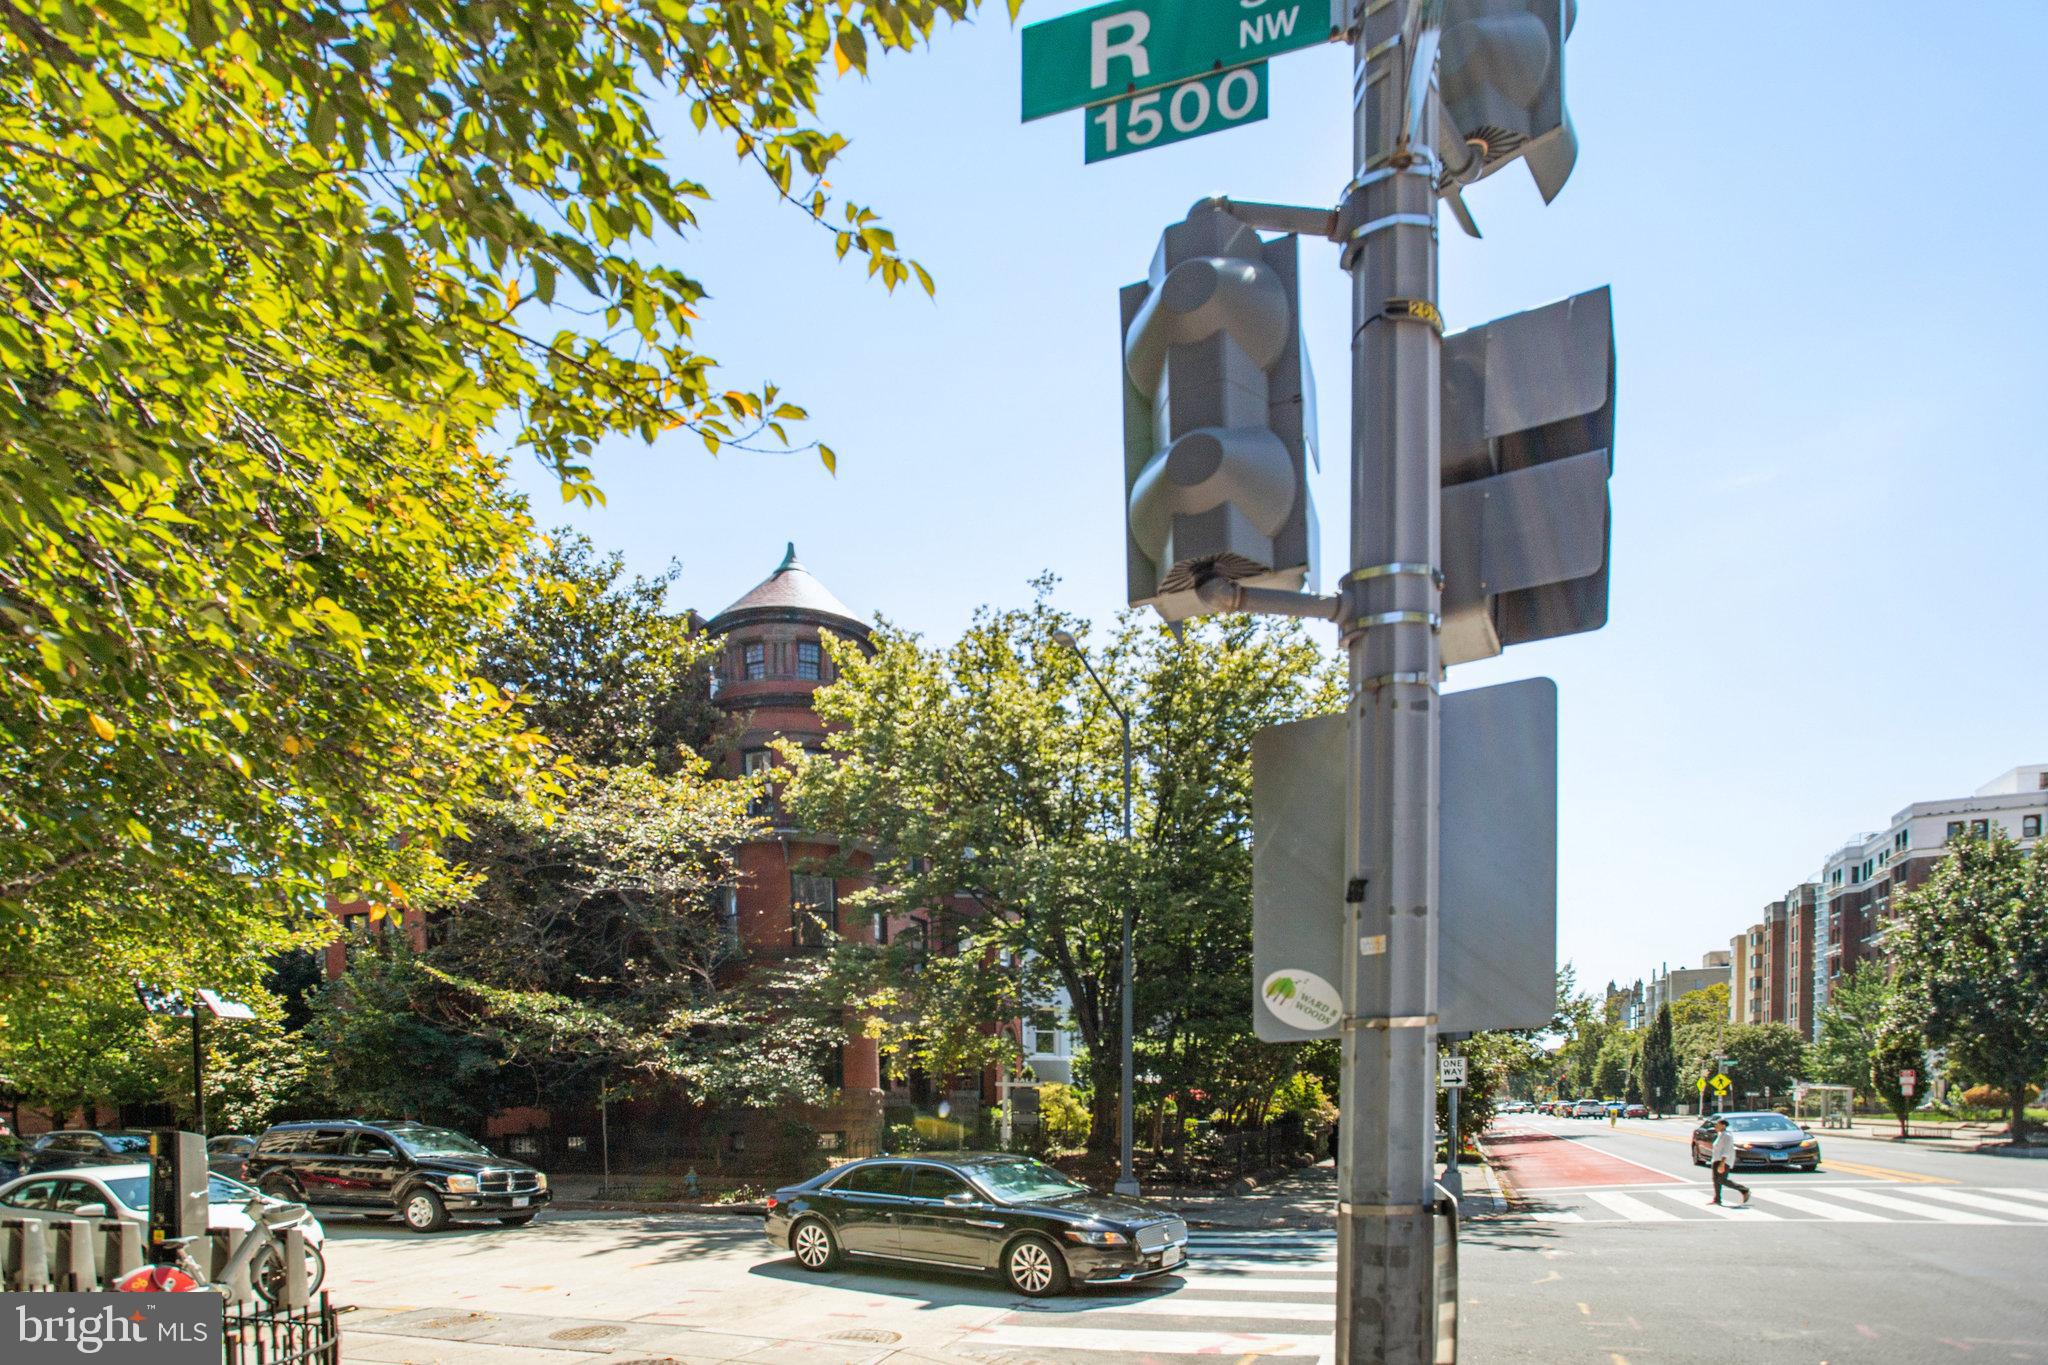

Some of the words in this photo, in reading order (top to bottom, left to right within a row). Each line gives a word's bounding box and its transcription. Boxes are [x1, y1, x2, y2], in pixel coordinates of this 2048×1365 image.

[1090, 10, 1150, 89] R
[1240, 6, 1299, 49] NW
[1095, 68, 1259, 152] 1500
[1295, 1000, 1332, 1025] WOODS
[1301, 992, 1330, 1013] WARD
[1443, 1059, 1463, 1067] ONE
